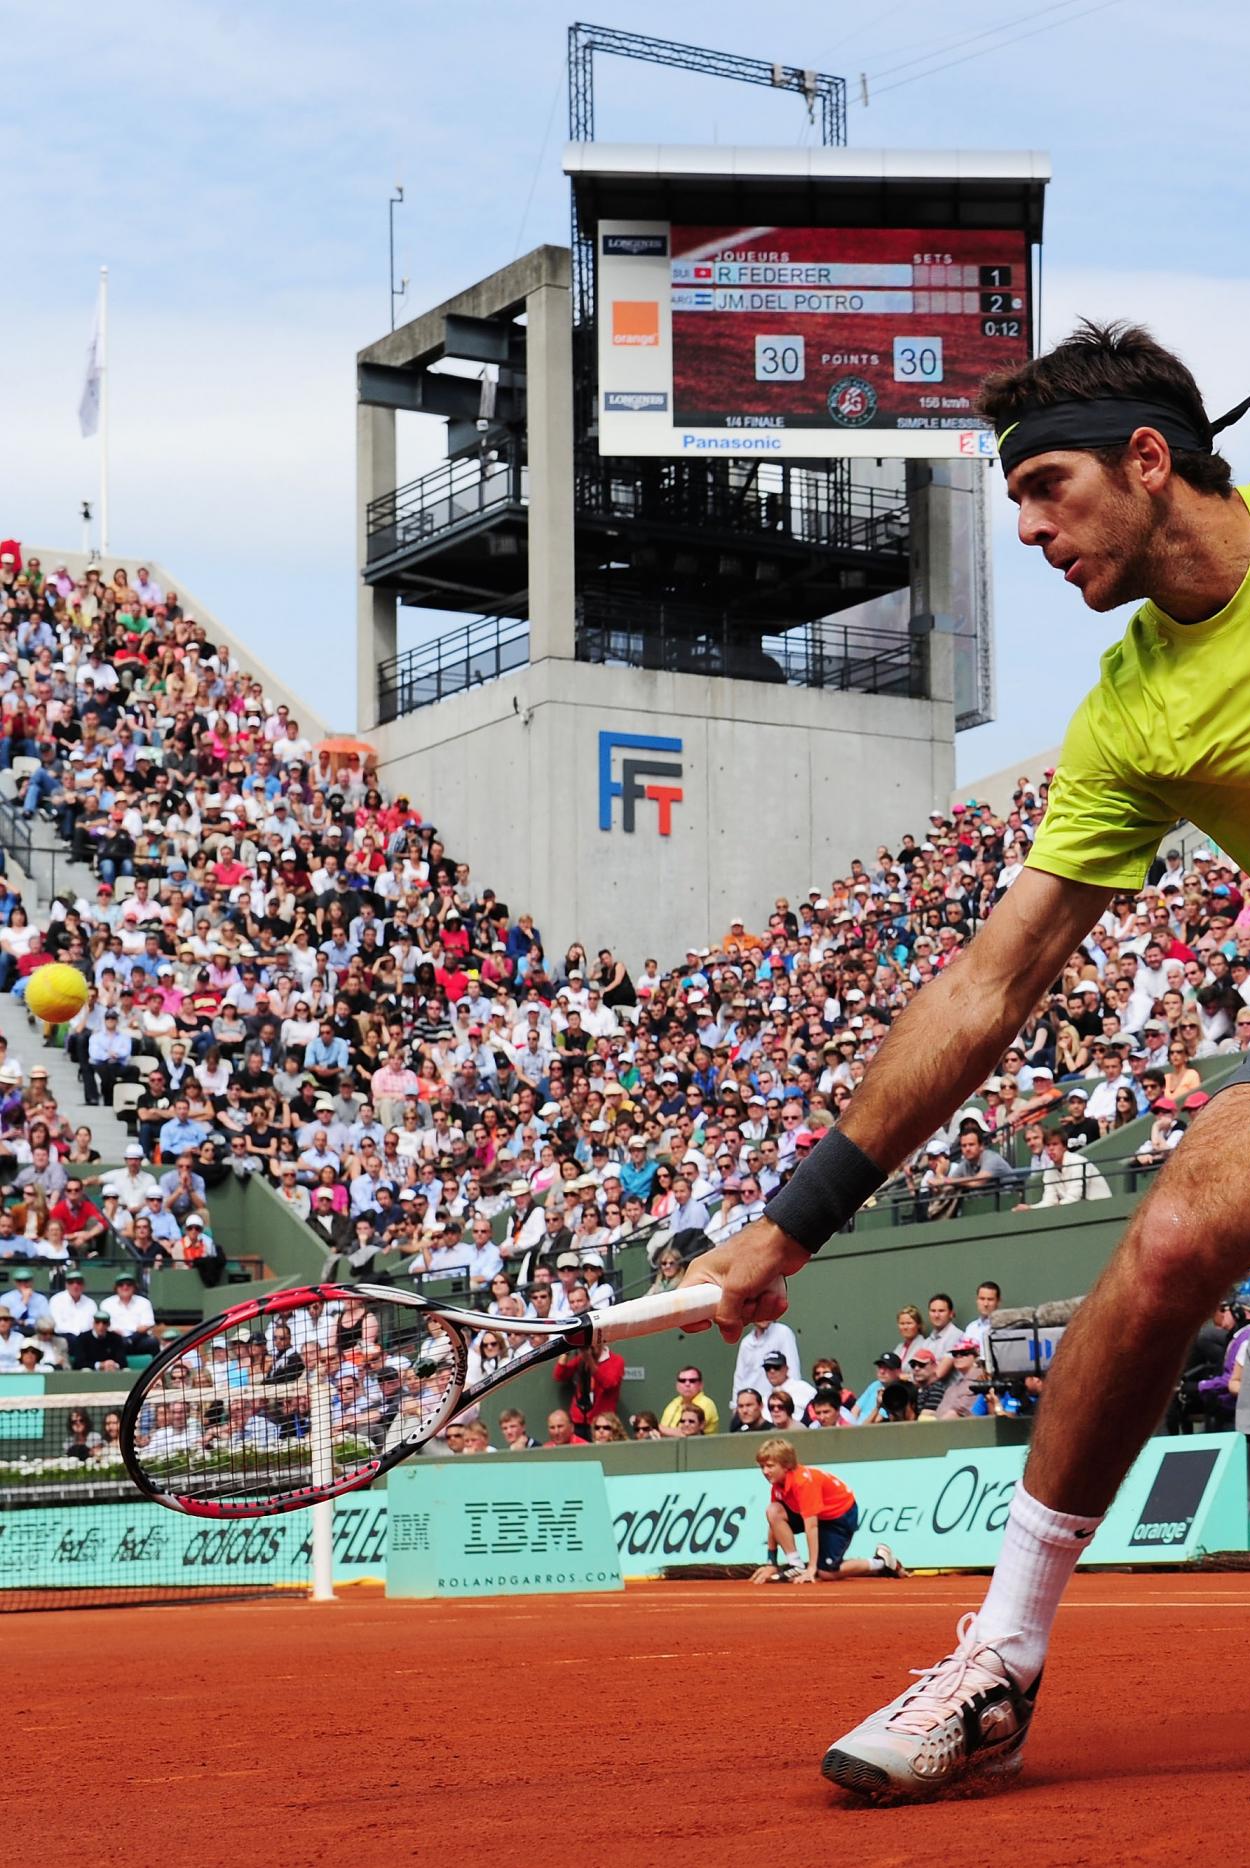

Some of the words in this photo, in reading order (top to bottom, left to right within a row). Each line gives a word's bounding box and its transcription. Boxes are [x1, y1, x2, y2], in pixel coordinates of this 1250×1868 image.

[714, 251, 790, 262] JOUEURS
[913, 254, 953, 265] SETS
[718, 266, 831, 283] R.FEDERER
[991, 269, 1001, 287] 1
[719, 294, 787, 311] JM.DEL
[794, 295, 864, 311] POTRO
[990, 295, 1003, 313] 2
[984, 321, 1019, 337] 0:12
[614, 334, 656, 346] orange
[761, 347, 799, 374] 30
[821, 354, 880, 366] POINTS
[900, 348, 937, 375] 30
[725, 416, 741, 428] 1/4
[744, 416, 785, 428] FINALE
[682, 434, 781, 449] Panasonic
[599, 731, 683, 836] FFT
[464, 1500, 583, 1555] IBM
[1133, 1522, 1187, 1543] orange
[438, 1571, 621, 1588] ROLANDGARROS.COM
